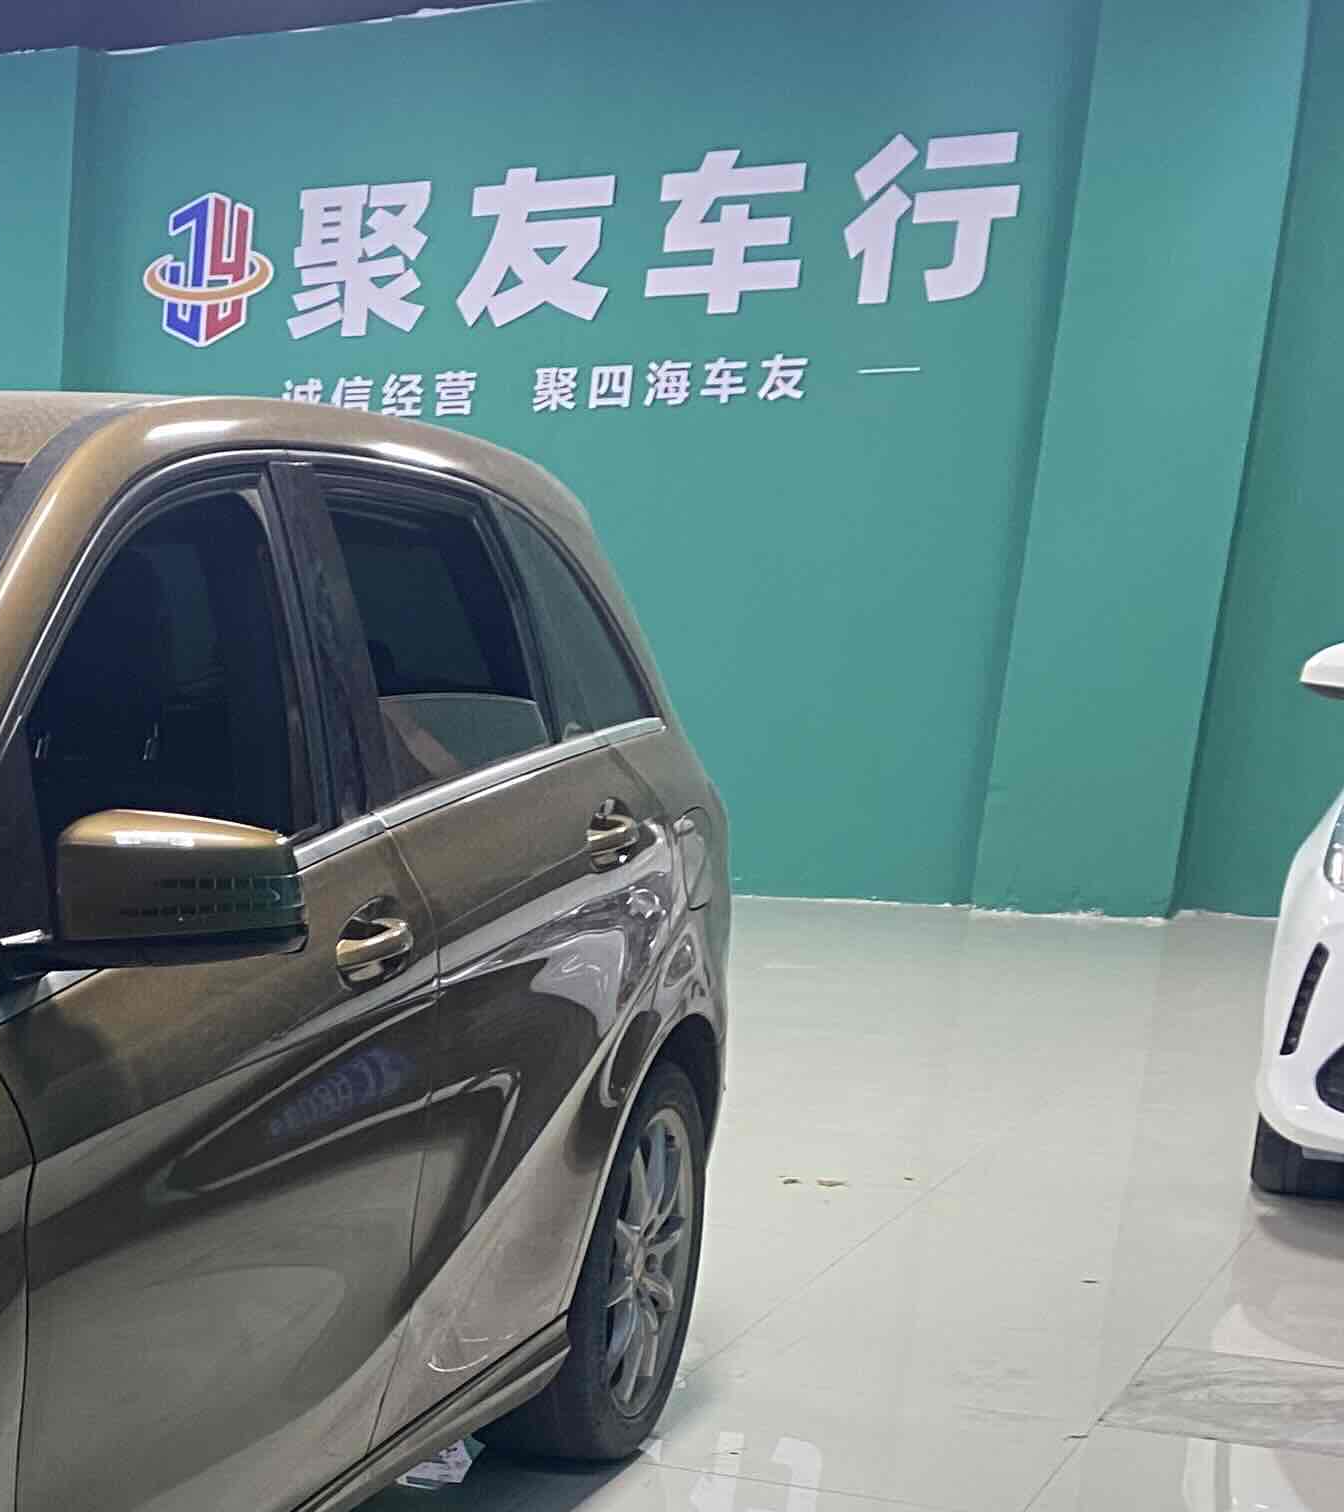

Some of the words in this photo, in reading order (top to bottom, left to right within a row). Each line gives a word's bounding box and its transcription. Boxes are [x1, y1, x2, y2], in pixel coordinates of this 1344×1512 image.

[285, 131, 1020, 340] 聚友车行
[531, 355, 810, 413] 聚四海车友
